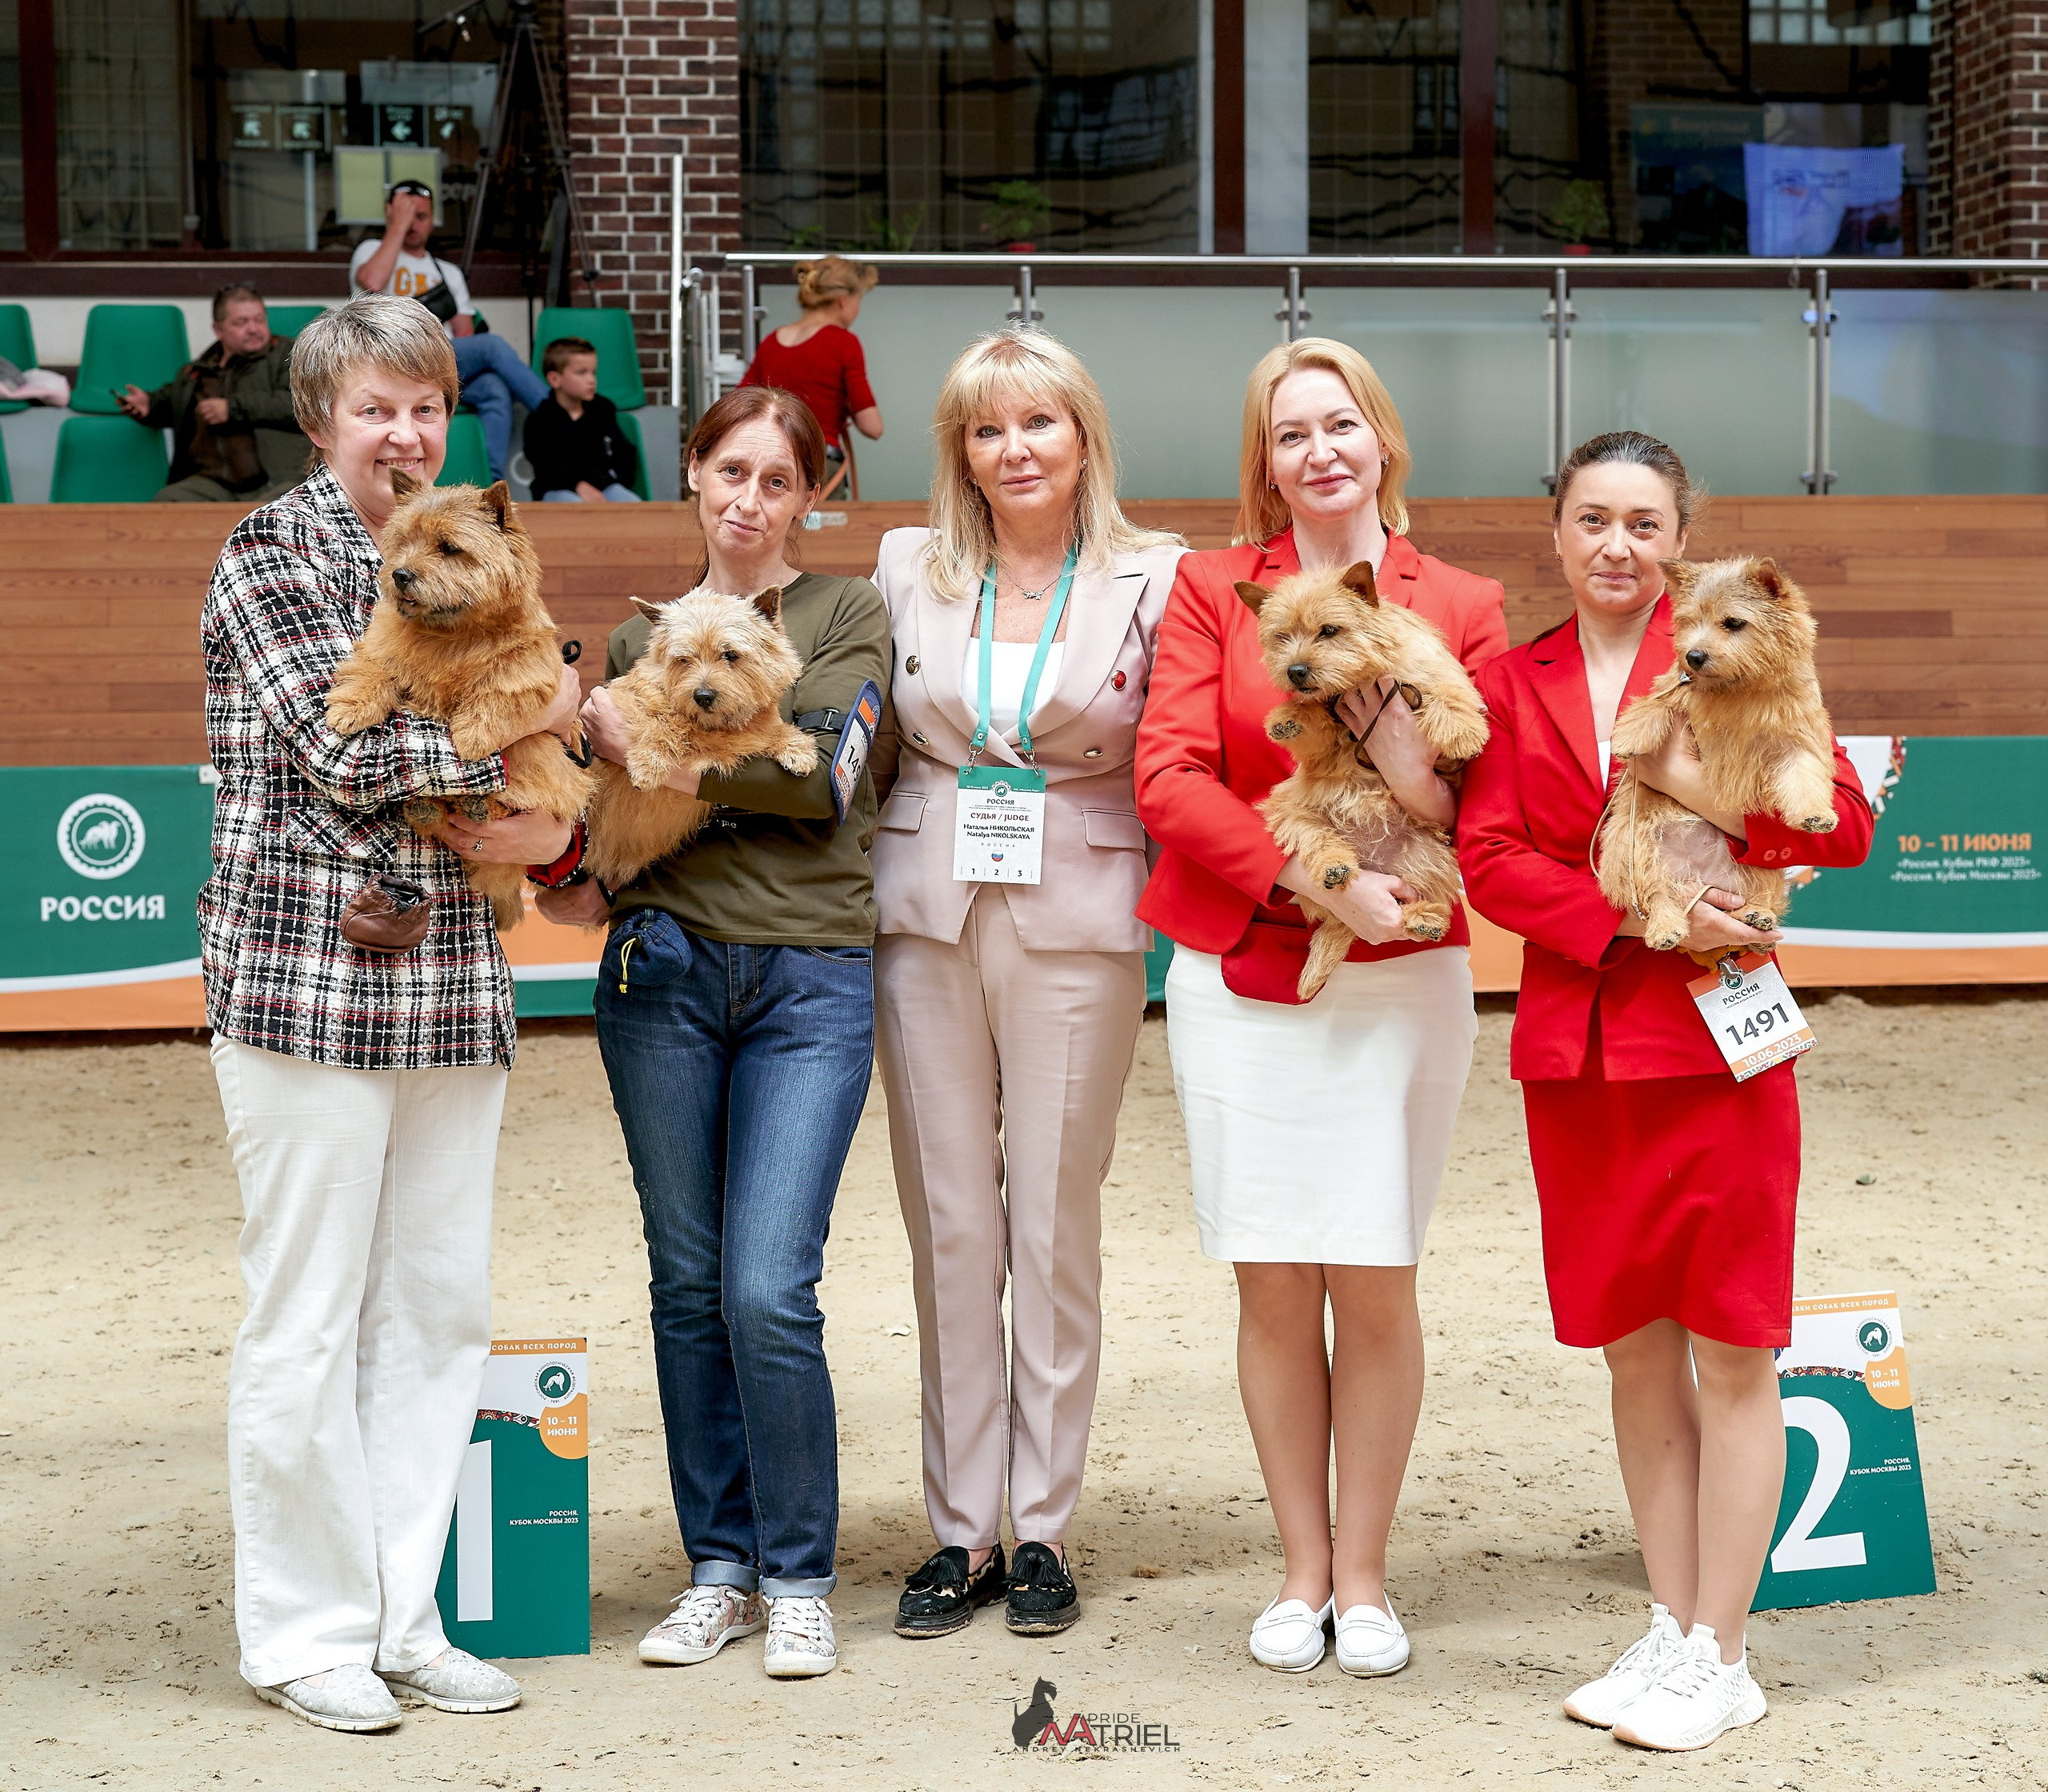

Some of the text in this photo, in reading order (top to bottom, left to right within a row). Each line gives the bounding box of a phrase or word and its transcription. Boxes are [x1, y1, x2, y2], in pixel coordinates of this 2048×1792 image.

[970, 812, 996, 820] СУДЬЯ
[989, 825, 1035, 833] НИКОЛЬСКАЯ
[990, 832, 1030, 840] NIKOLSKAYA
[1897, 834, 1922, 853] 10
[1939, 834, 1959, 853] 11
[1962, 833, 2033, 853] ИЮНЯ
[40, 894, 166, 922] РОССИЯ
[1722, 982, 1760, 1006] РОССИЯ
[1726, 1002, 1790, 1046] 1491
[1742, 1034, 1802, 1068] 10.06.2023
[1812, 1302, 1838, 1310] СОБАК
[1862, 1298, 1889, 1306] ПОРОД
[1870, 1370, 1882, 1378] 10
[1889, 1368, 1898, 1377] 11
[1872, 1379, 1900, 1389] ИЮНЯ
[546, 1417, 558, 1426] 10
[567, 1416, 578, 1425] 11
[547, 1428, 578, 1436] ИЮНЯ
[1870, 1466, 1898, 1474] МОСКВЫ
[1770, 1395, 1867, 1574] 2
[457, 1439, 493, 1622] 1
